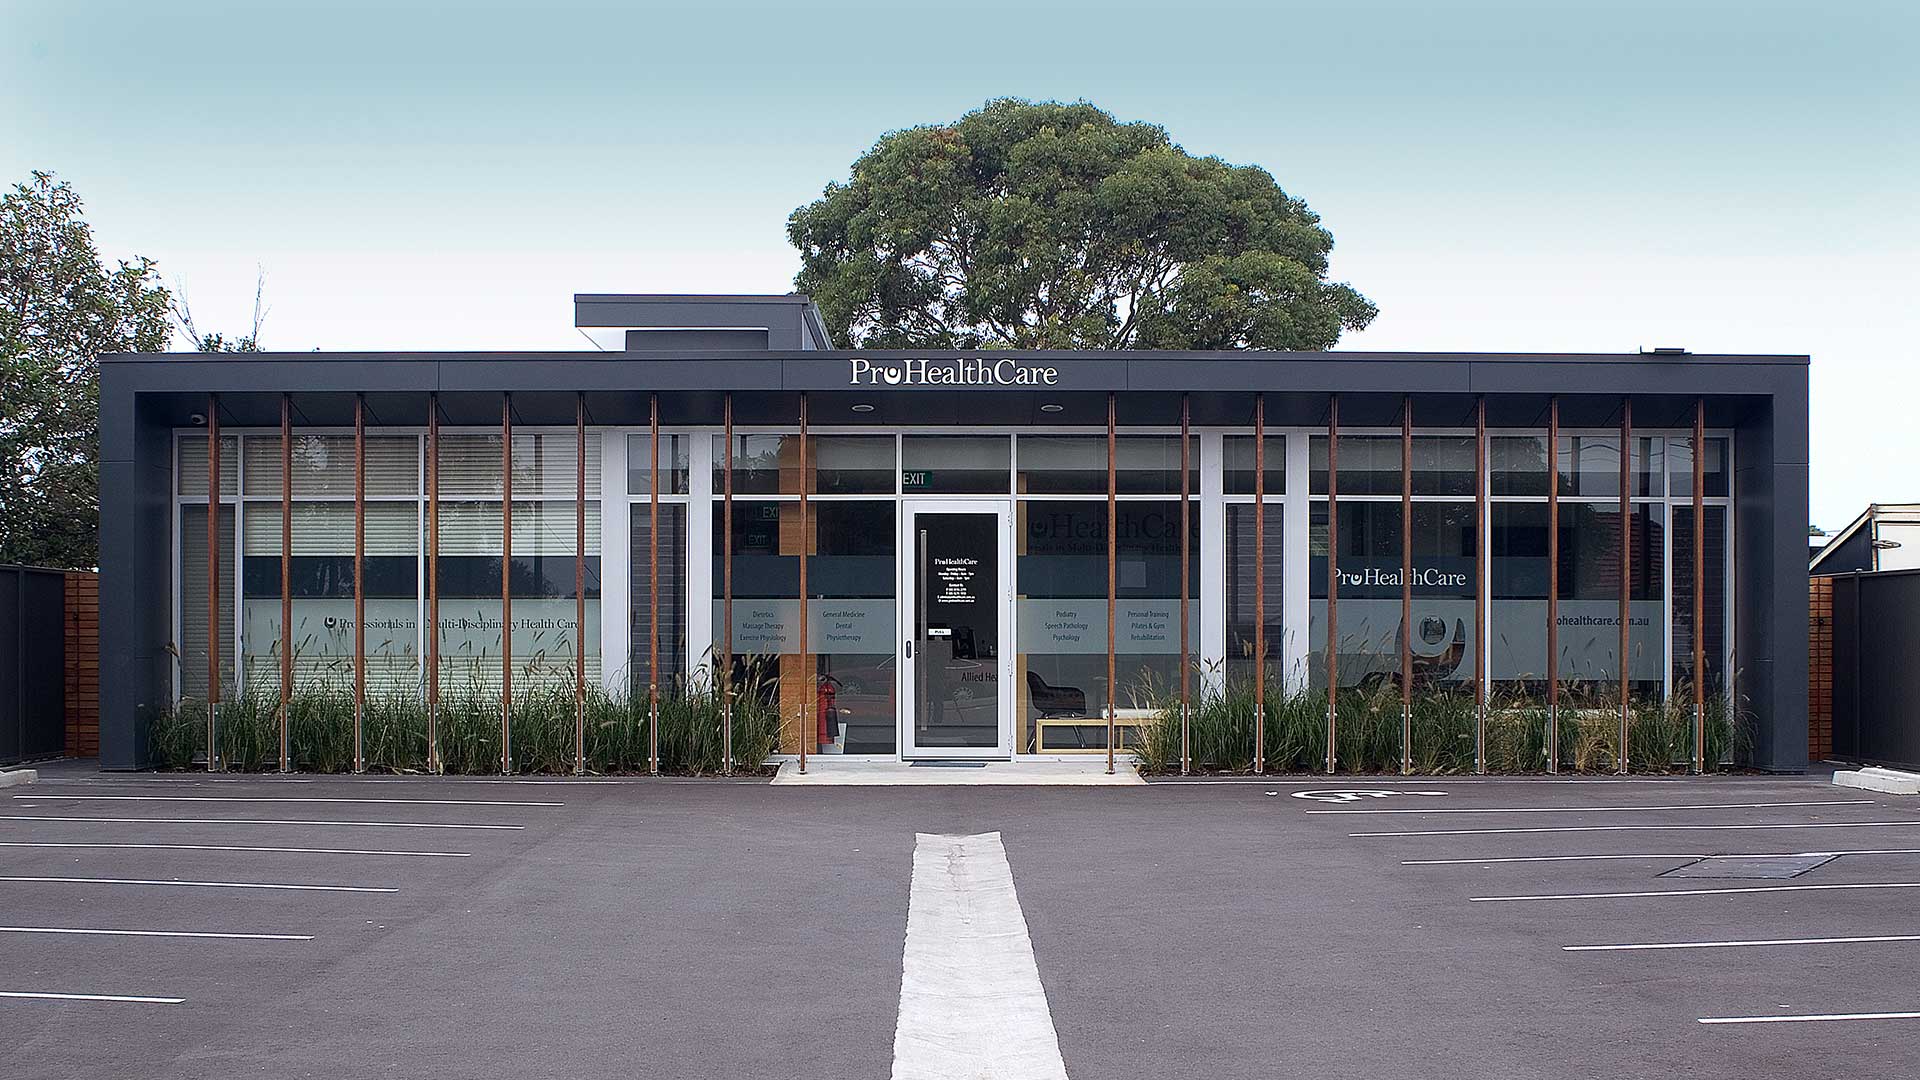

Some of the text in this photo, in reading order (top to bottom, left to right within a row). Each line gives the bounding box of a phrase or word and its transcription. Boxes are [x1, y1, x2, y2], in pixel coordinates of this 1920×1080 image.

[849, 358, 1058, 385] ProHealthCare
[902, 472, 926, 485] EXIT
[762, 506, 779, 518] EXI
[748, 534, 768, 545] EXIT
[1333, 568, 1466, 586] ProHealhCare
[1149, 611, 1170, 619] Training
[406, 619, 415, 629] in
[521, 619, 554, 629] Health
[742, 622, 784, 630] Massage Therapy
[1044, 622, 1089, 630] Speech Pathology
[1153, 622, 1165, 630] Gym
[760, 634, 786, 642] Physiology
[826, 634, 861, 642] Physiotherapy
[1052, 634, 1080, 642] Psychology
[1131, 633, 1165, 641] Rehabilitation
[961, 672, 984, 682] Allied
